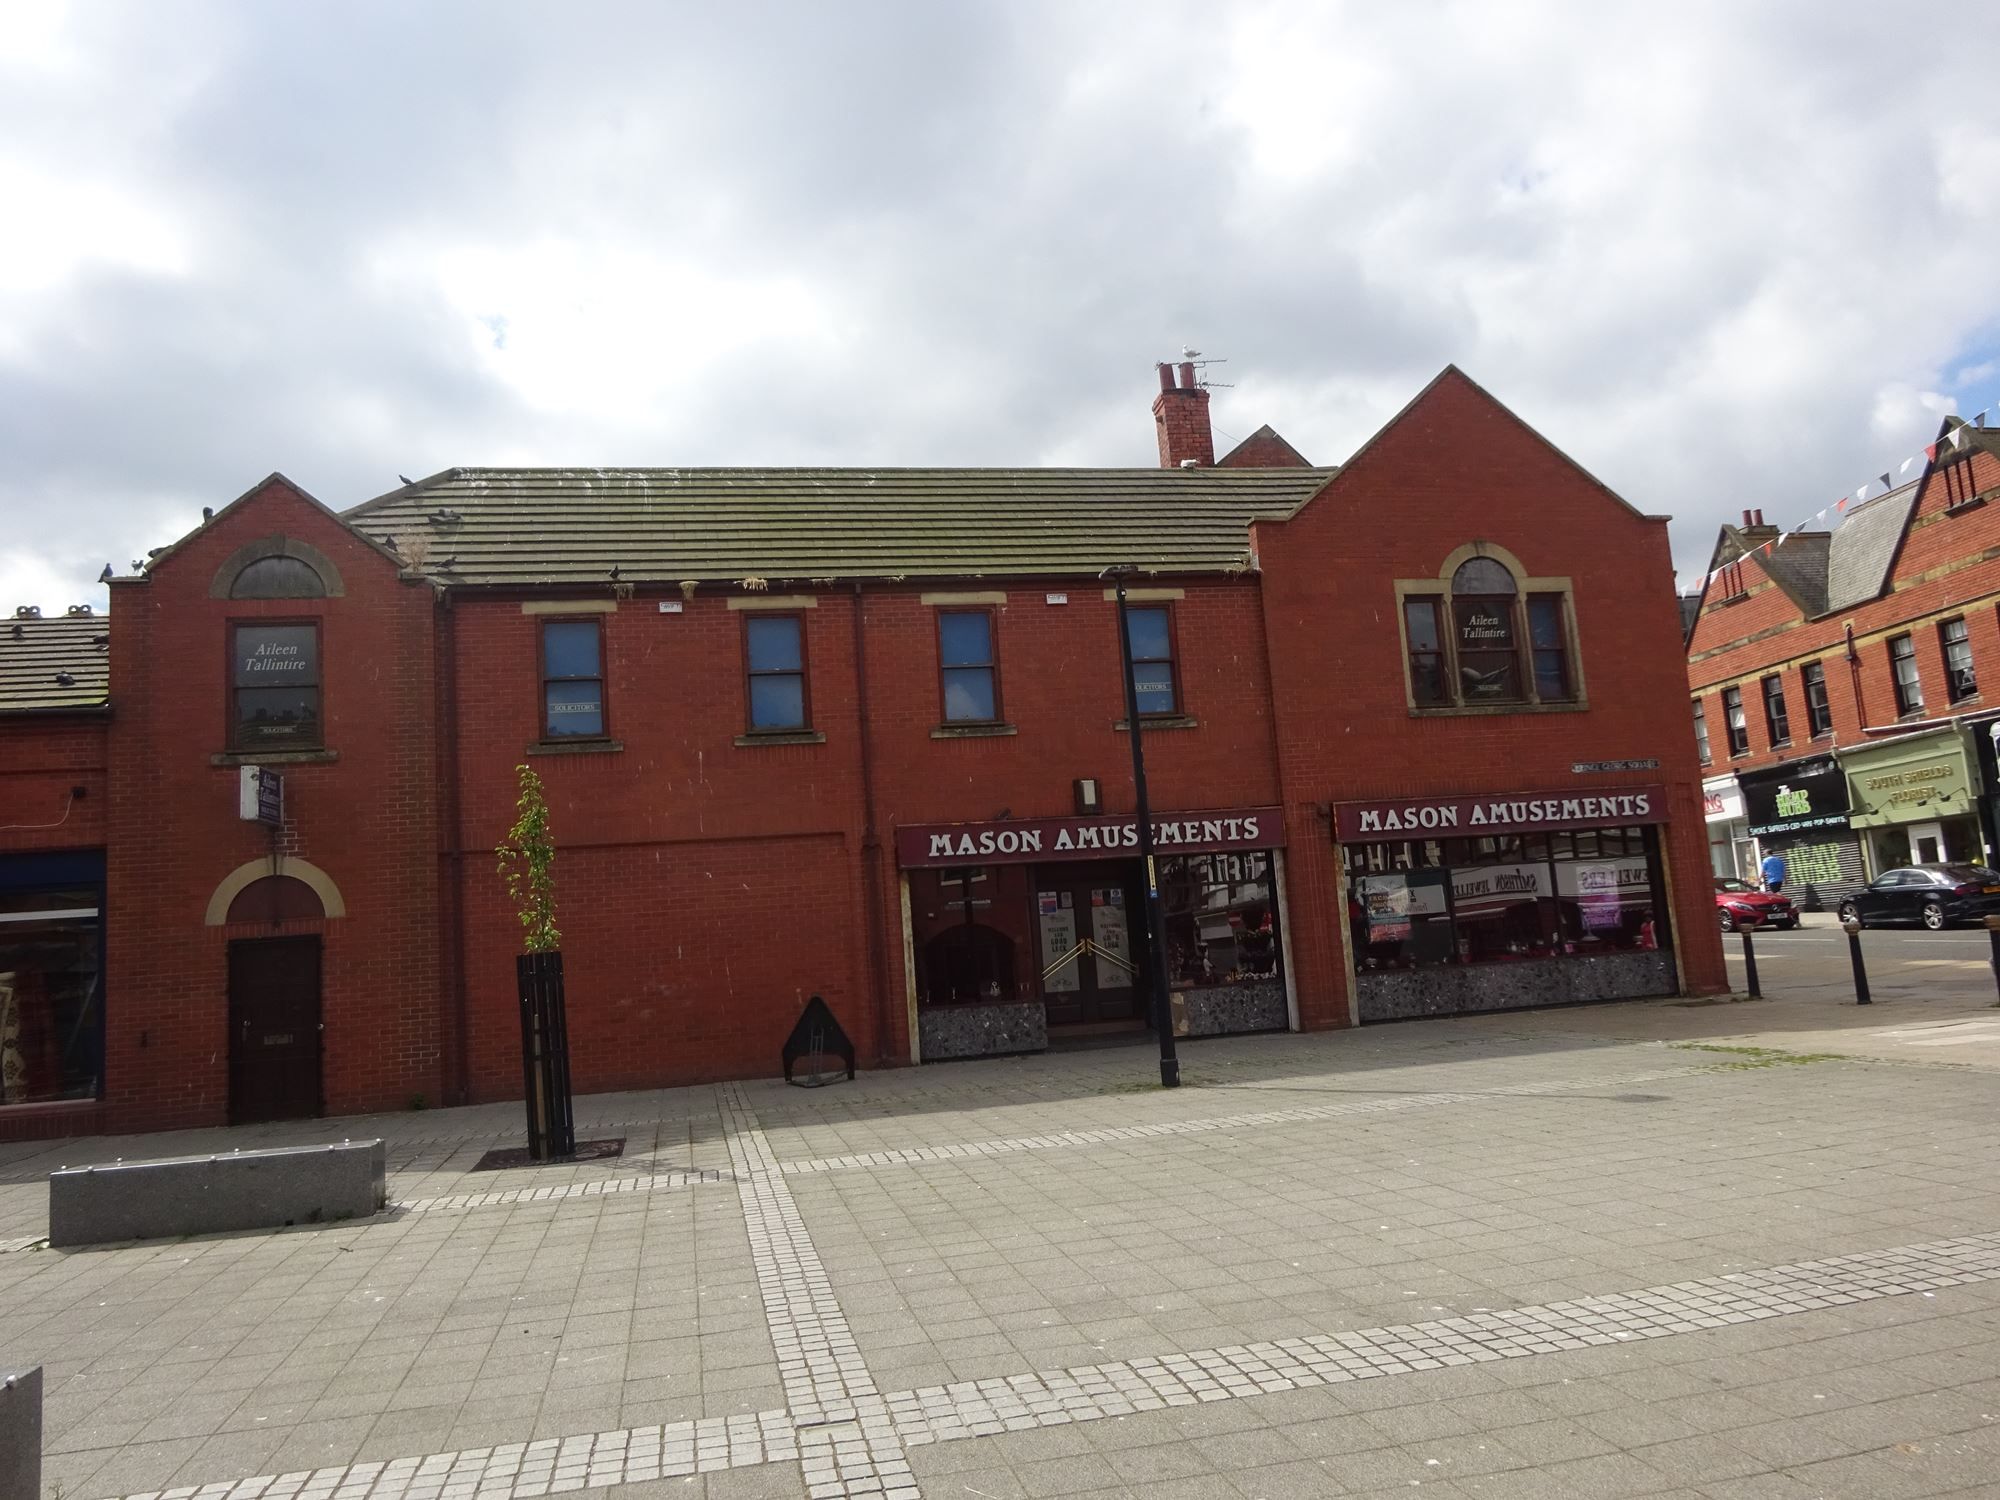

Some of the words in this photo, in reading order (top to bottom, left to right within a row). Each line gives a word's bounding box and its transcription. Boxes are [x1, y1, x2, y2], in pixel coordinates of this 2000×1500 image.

[1468, 614, 1499, 626] Aileen
[1462, 627, 1506, 639] Tallintire
[255, 642, 298, 656] Aileen
[246, 657, 306, 671] Tallintire
[553, 704, 595, 712] SOLICITORS
[1866, 774, 1903, 789] SOUTH
[1904, 765, 1953, 783] SHIELDS
[1889, 786, 1937, 803] FLORIST
[1359, 805, 1458, 833] MASON
[1468, 794, 1650, 827] AMUSEMENTS
[928, 829, 1043, 857] MASON
